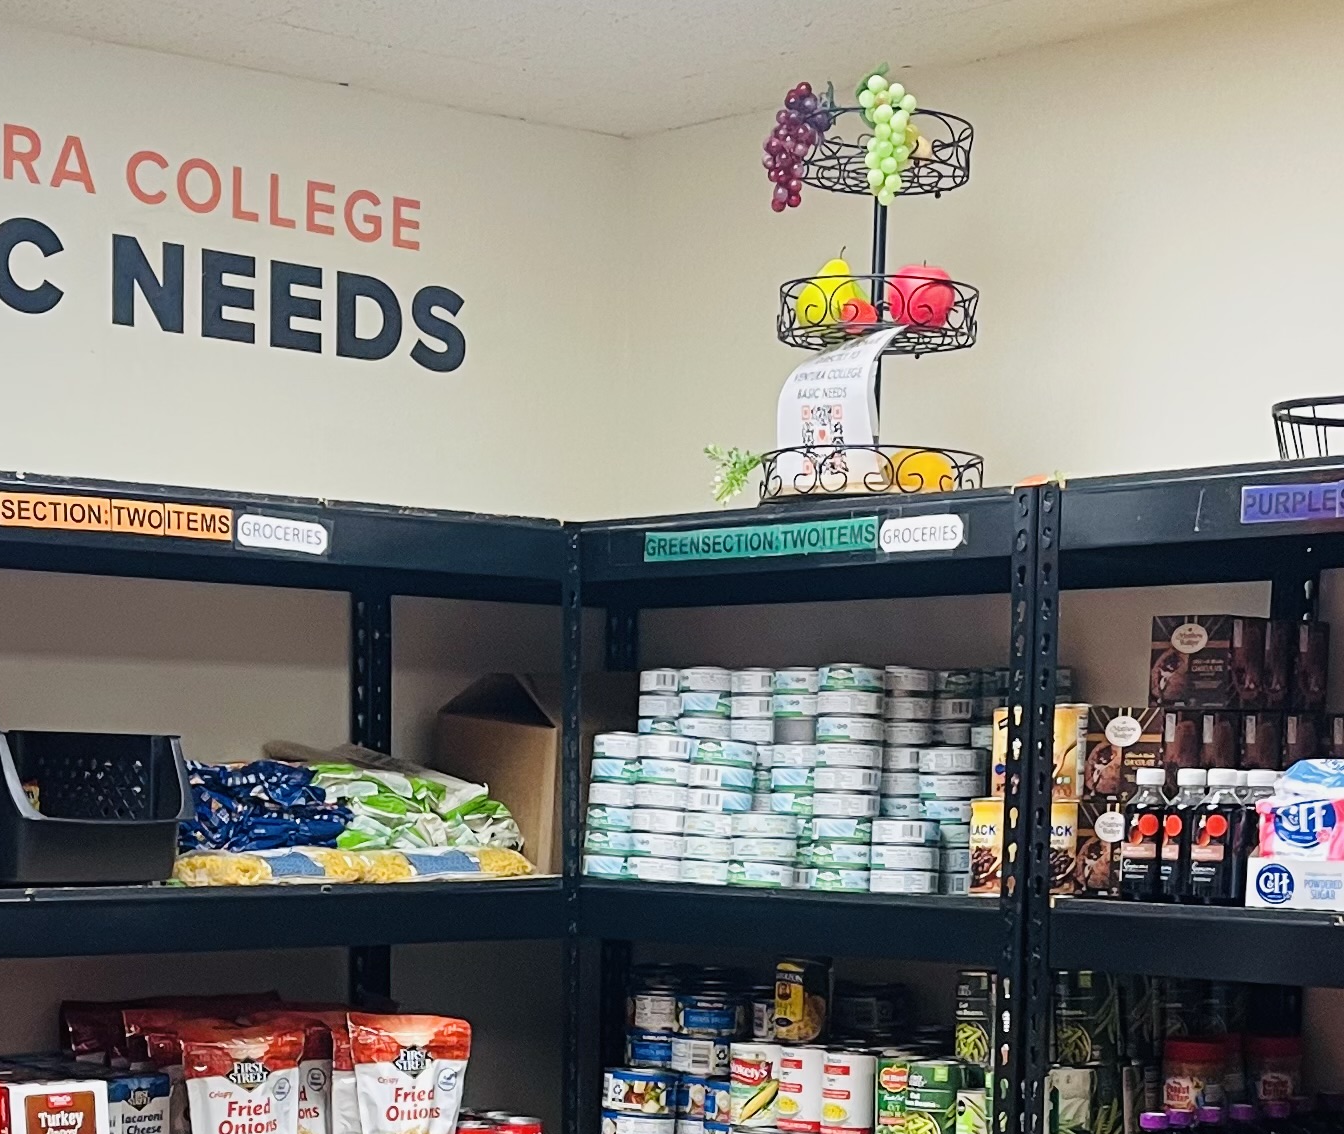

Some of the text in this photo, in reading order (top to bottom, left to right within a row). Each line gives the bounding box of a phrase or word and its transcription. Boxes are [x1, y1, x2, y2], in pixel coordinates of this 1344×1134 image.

[126, 149, 423, 252] COLLEGE
[112, 233, 468, 374] NEEDS
[822, 386, 848, 399] NEEDS
[1245, 486, 1336, 517] PURPLE
[113, 505, 163, 531] TWO
[166, 510, 231, 534] ITEMS
[240, 520, 323, 547] GROCERIES
[646, 535, 702, 556] GREEN
[780, 528, 820, 549] TWO
[820, 523, 875, 547] ITEMS
[882, 524, 958, 546] GROCERIES
[971, 823, 997, 837] LACK
[1259, 871, 1290, 895] C&H
[1309, 889, 1336, 900] SUGAR
[398, 1047, 429, 1061] FIRST
[233, 1060, 267, 1074] FIRST
[227, 1072, 270, 1085] STREET
[394, 1085, 436, 1104] Fried
[226, 1097, 272, 1119] Fried
[385, 1104, 441, 1122] Onions
[37, 1110, 84, 1130] Turkey
